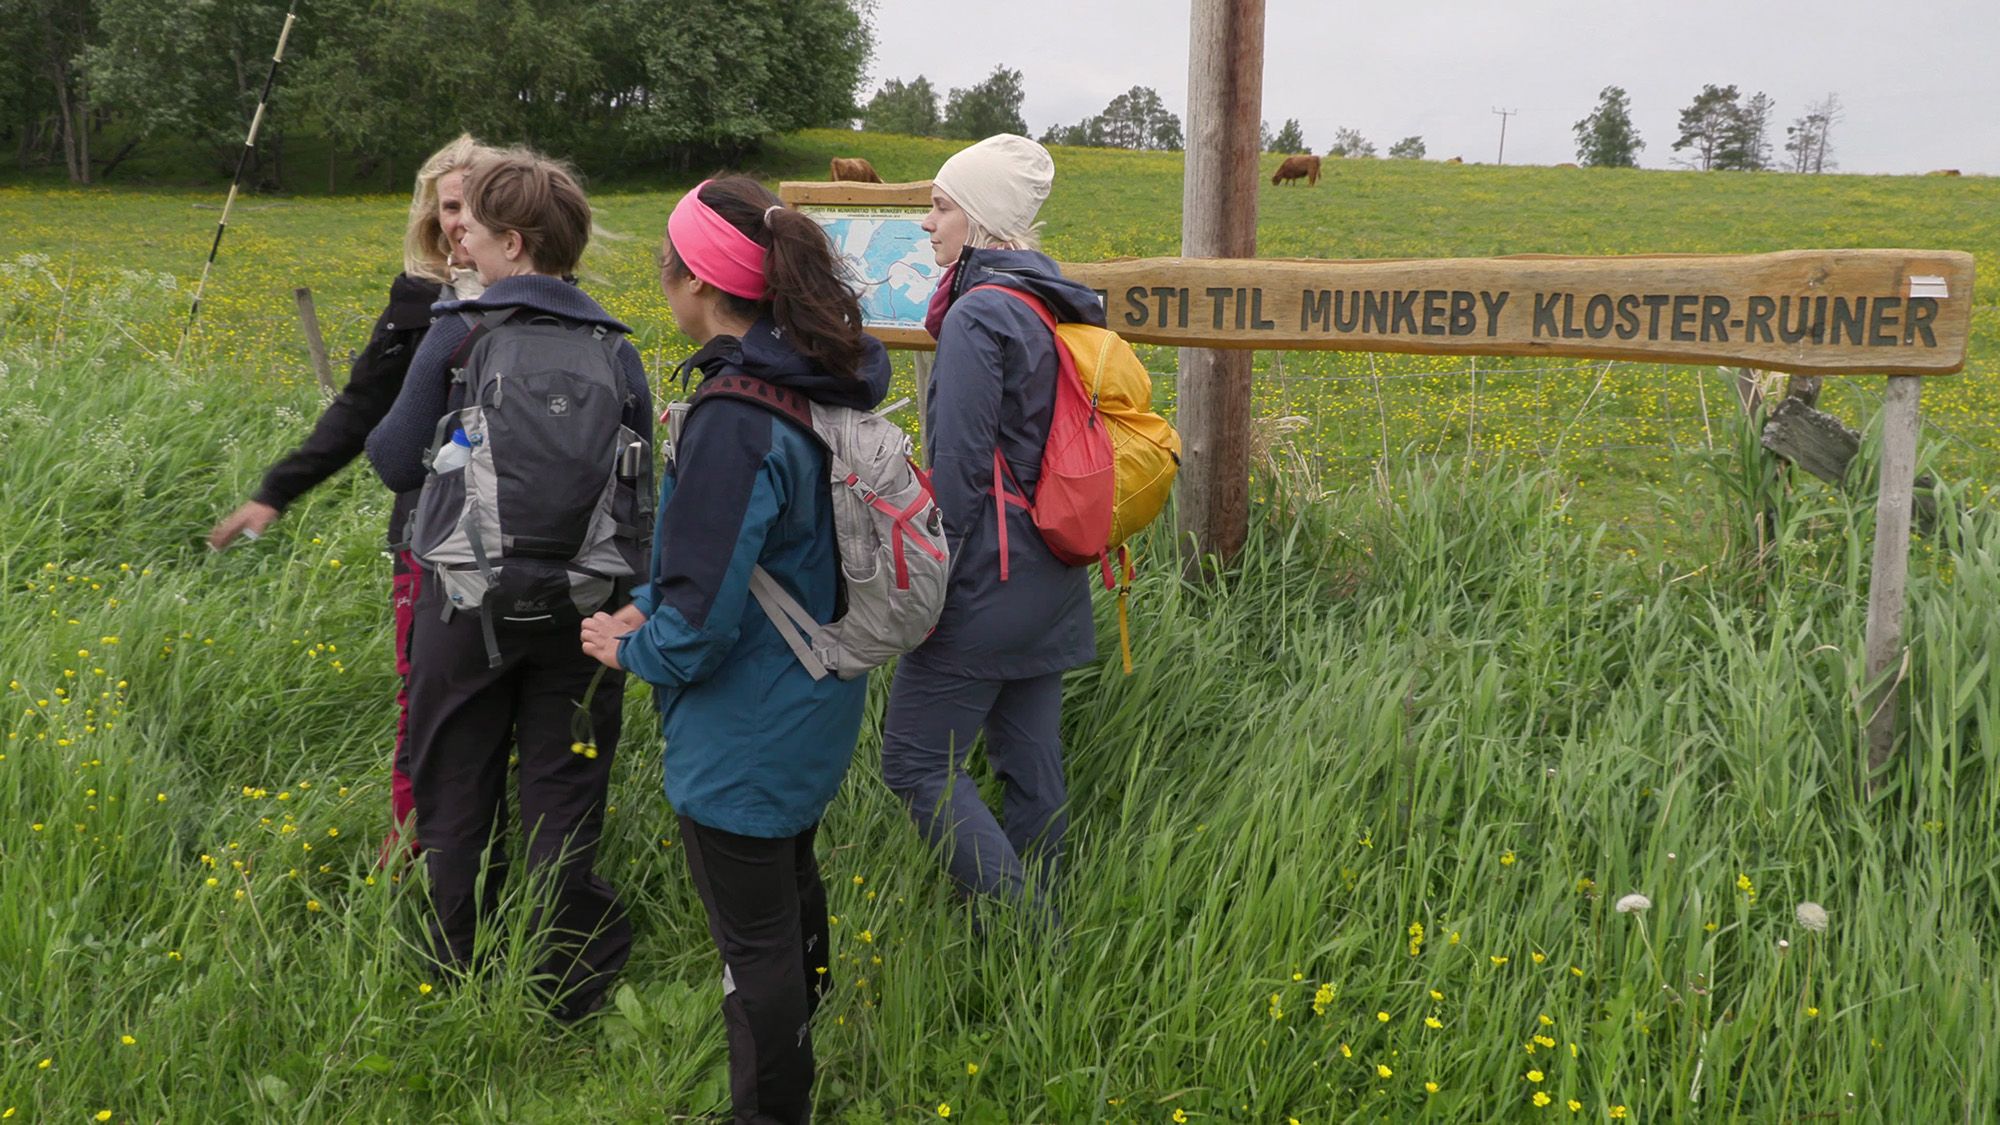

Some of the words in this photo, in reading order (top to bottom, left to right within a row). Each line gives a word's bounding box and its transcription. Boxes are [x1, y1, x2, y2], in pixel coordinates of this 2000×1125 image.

[1125, 286, 1189, 328] STI
[1207, 287, 1275, 331] TIL
[1301, 289, 1510, 337] MUNKEBY
[1532, 292, 1938, 348] KLOSTER-RUINER
